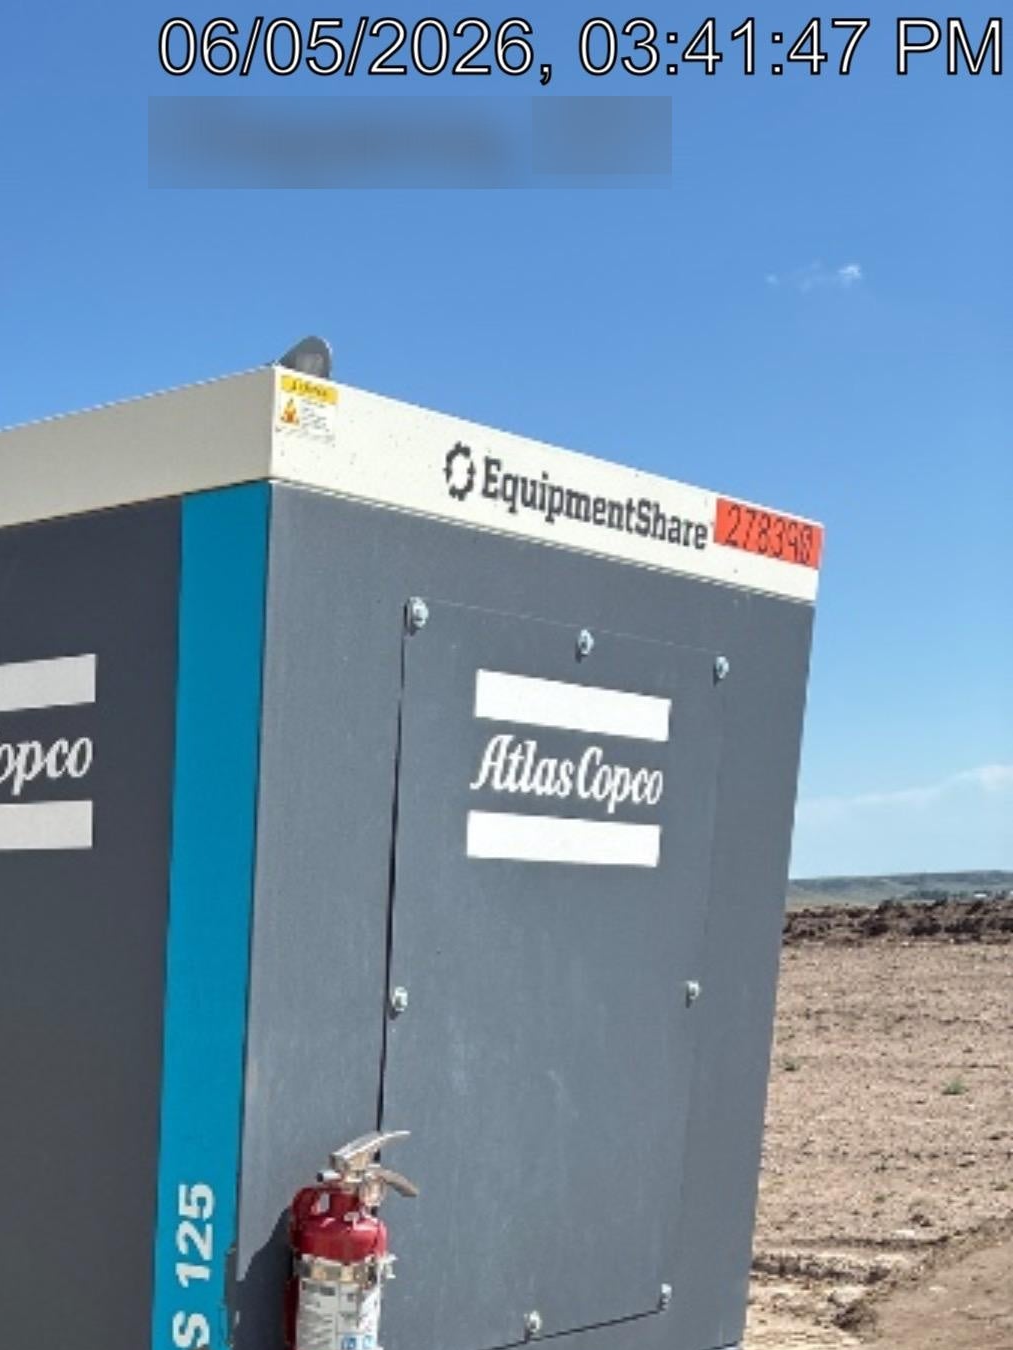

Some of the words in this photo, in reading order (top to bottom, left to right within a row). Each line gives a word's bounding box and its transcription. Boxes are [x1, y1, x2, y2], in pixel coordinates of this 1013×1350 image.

[481, 455, 709, 551] EquipmentShare
[469, 734, 575, 798] Atlas
[577, 745, 664, 814] Copco
[175, 1183, 215, 1288] 125
